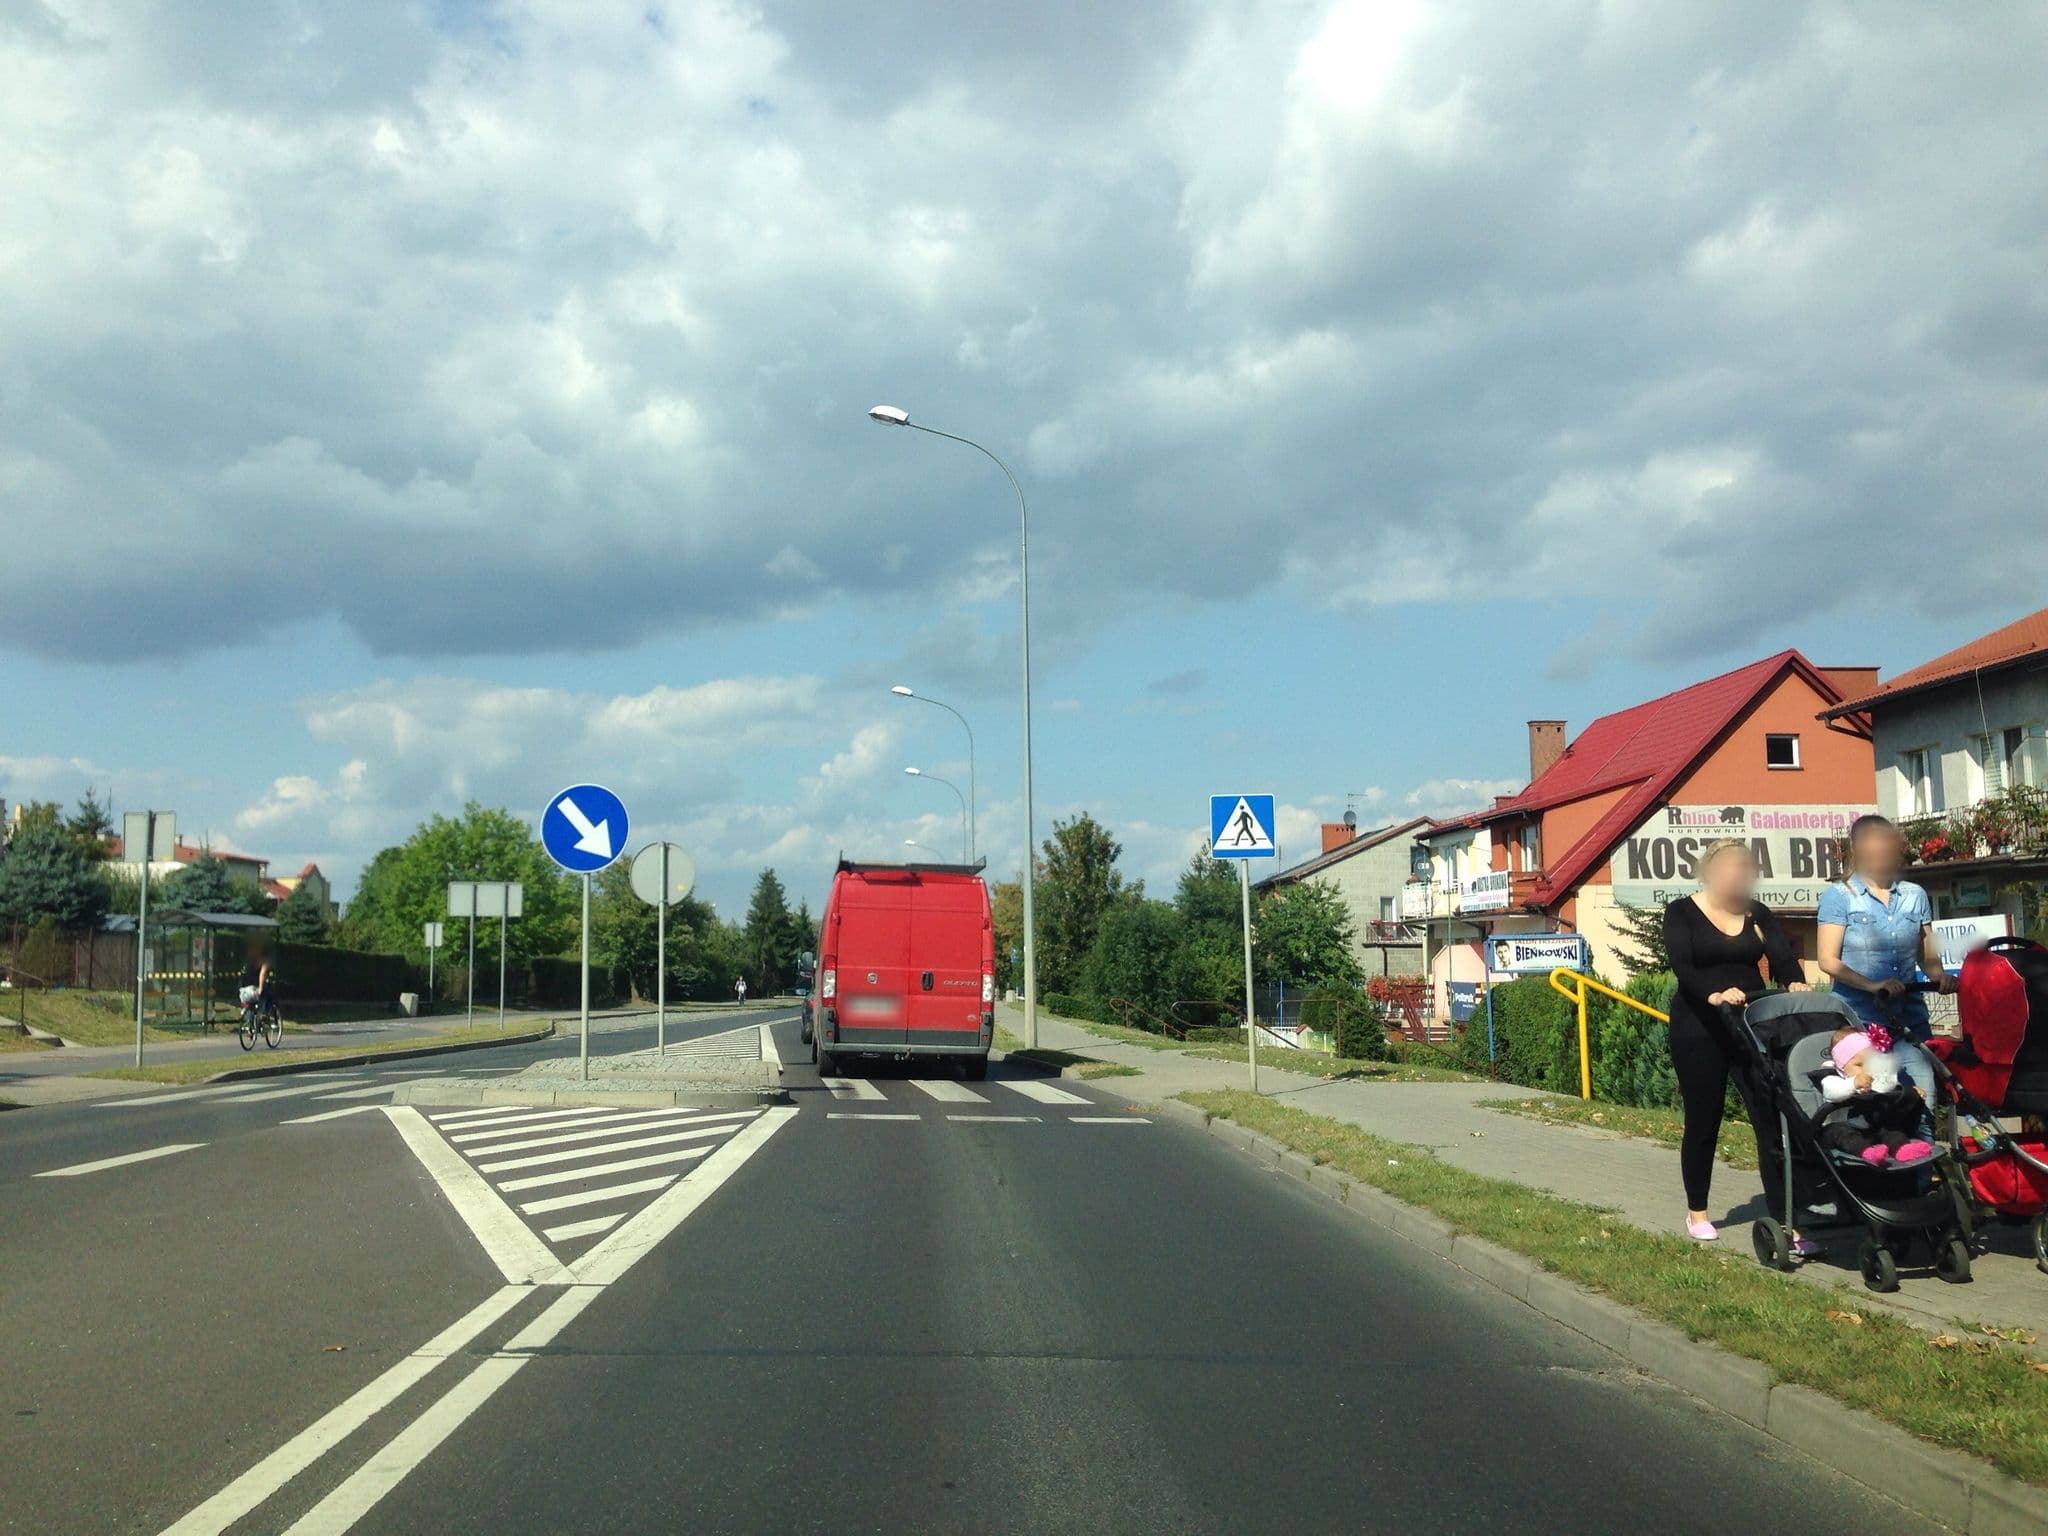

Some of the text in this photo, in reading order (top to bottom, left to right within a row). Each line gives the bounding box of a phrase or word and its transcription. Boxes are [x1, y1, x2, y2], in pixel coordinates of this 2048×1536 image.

[1668, 807, 1716, 825] Rhino
[1750, 811, 1845, 829] Galanteria
[1627, 837, 1774, 880] KOSA
[1793, 889, 1810, 902] Ci
[1515, 944, 1578, 962] BIEŃKOWSKI
